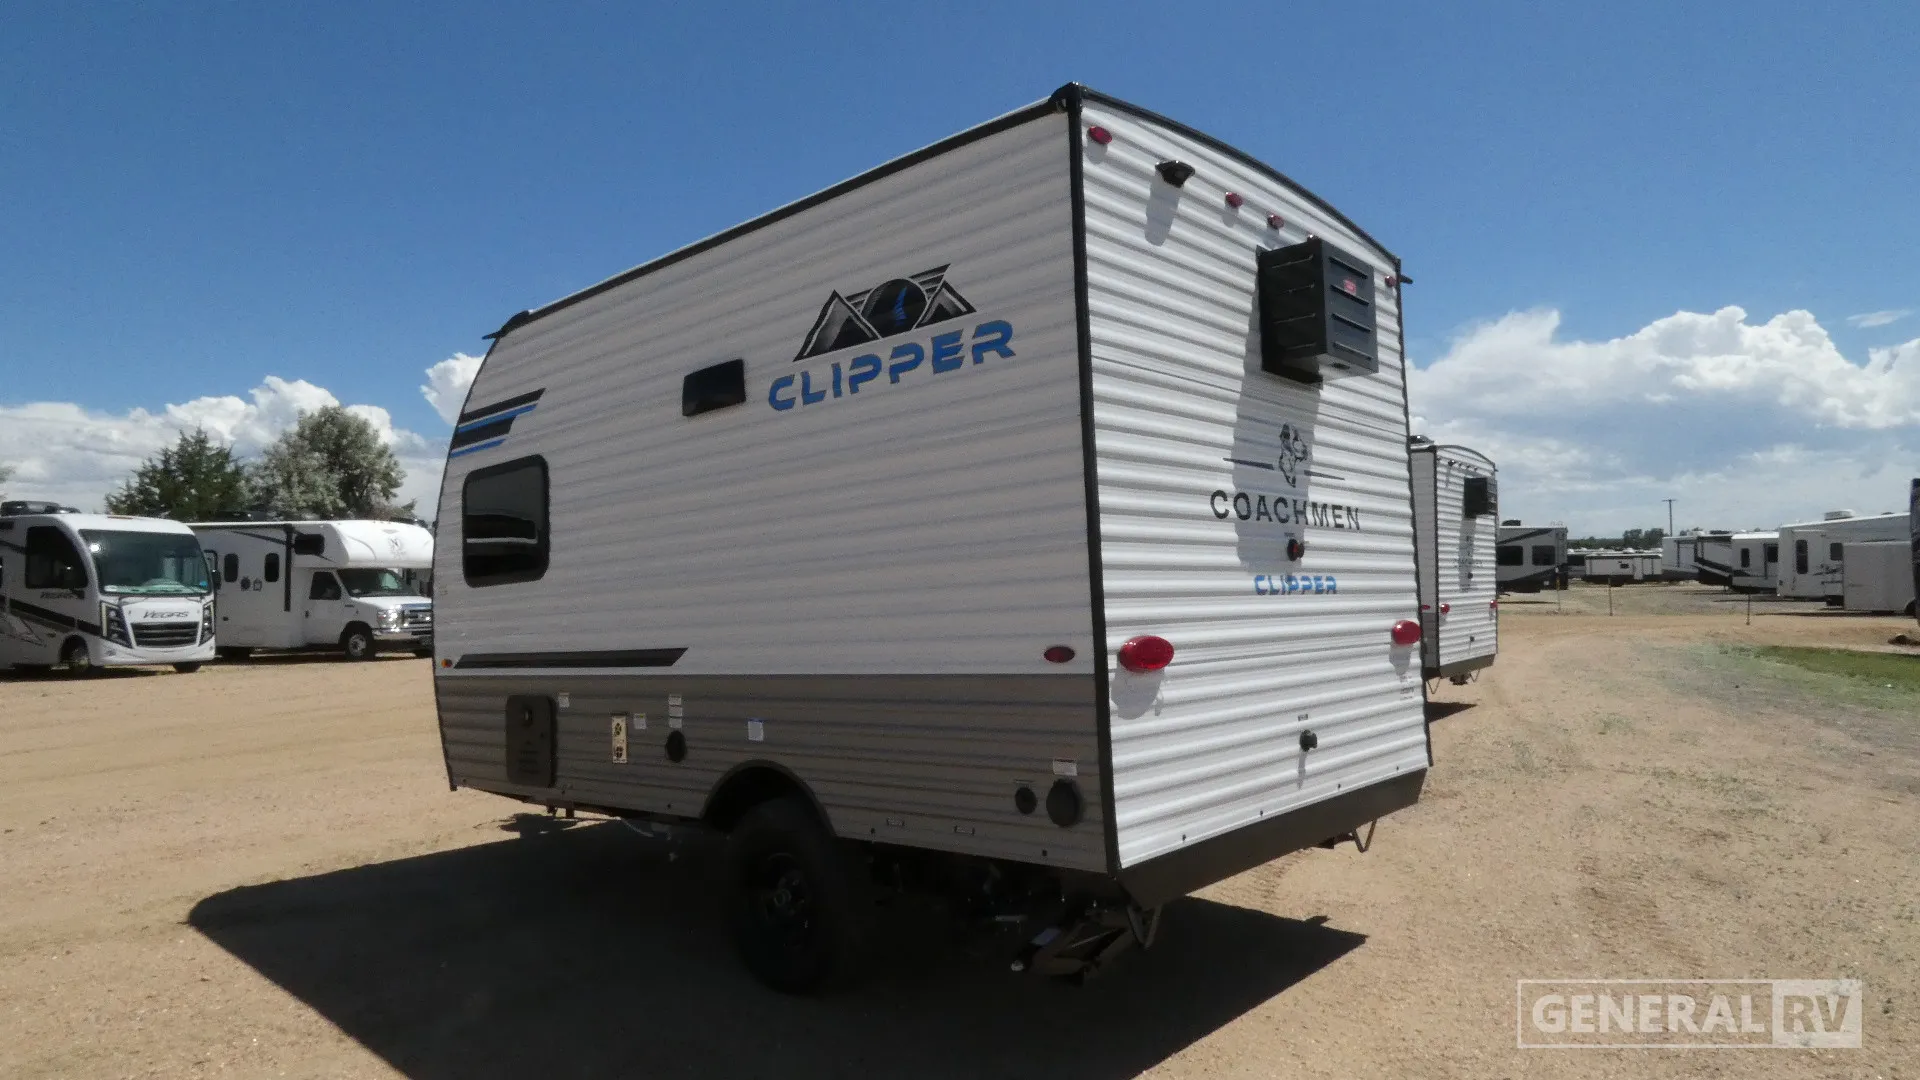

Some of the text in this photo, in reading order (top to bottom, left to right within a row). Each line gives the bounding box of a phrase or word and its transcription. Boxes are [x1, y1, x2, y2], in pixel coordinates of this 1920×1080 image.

[768, 319, 1016, 412] CLIPPER
[1210, 489, 1360, 530] COACHMEN
[1254, 574, 1337, 595] CLIPPER
